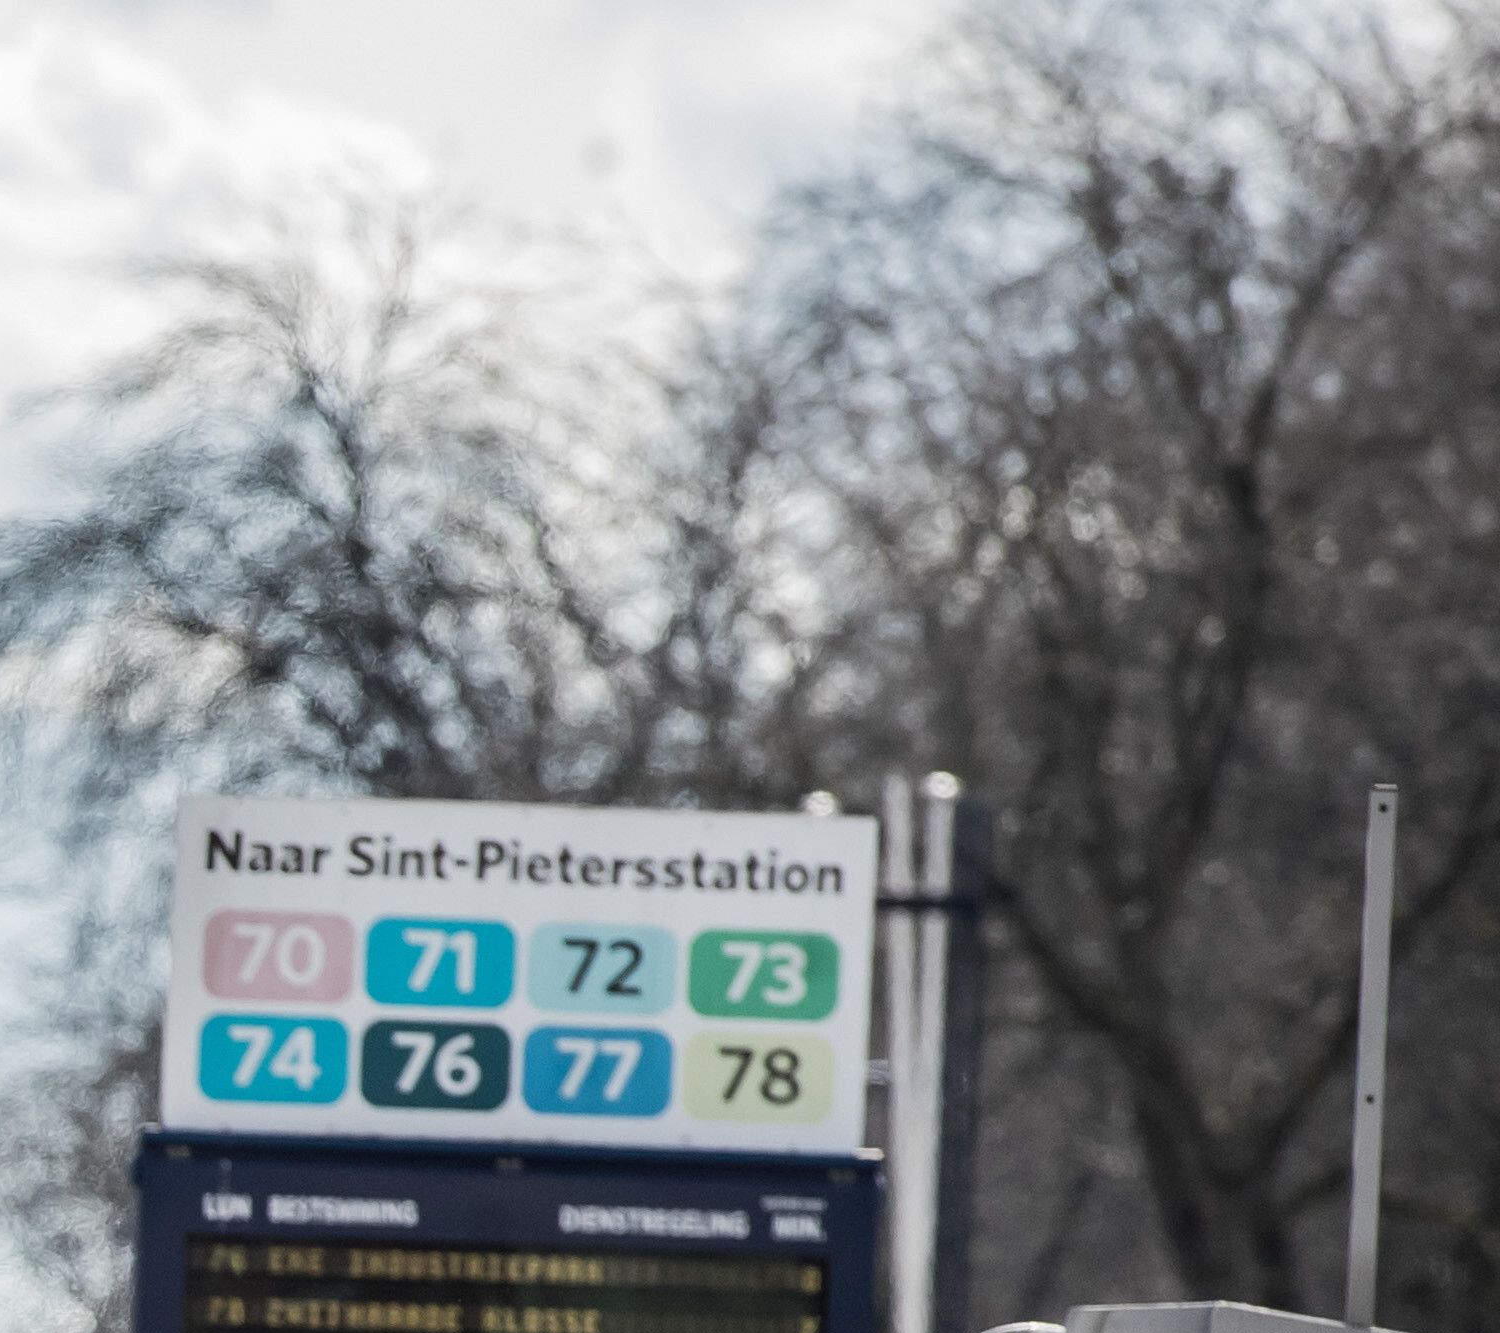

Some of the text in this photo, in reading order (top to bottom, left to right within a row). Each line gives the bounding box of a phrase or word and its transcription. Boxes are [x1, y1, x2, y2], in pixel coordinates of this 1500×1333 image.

[204, 830, 844, 895] Naar Sint-Pietersstation
[229, 921, 809, 1006] 70 71 72 73
[226, 1023, 801, 1105] 74 76 77 78
